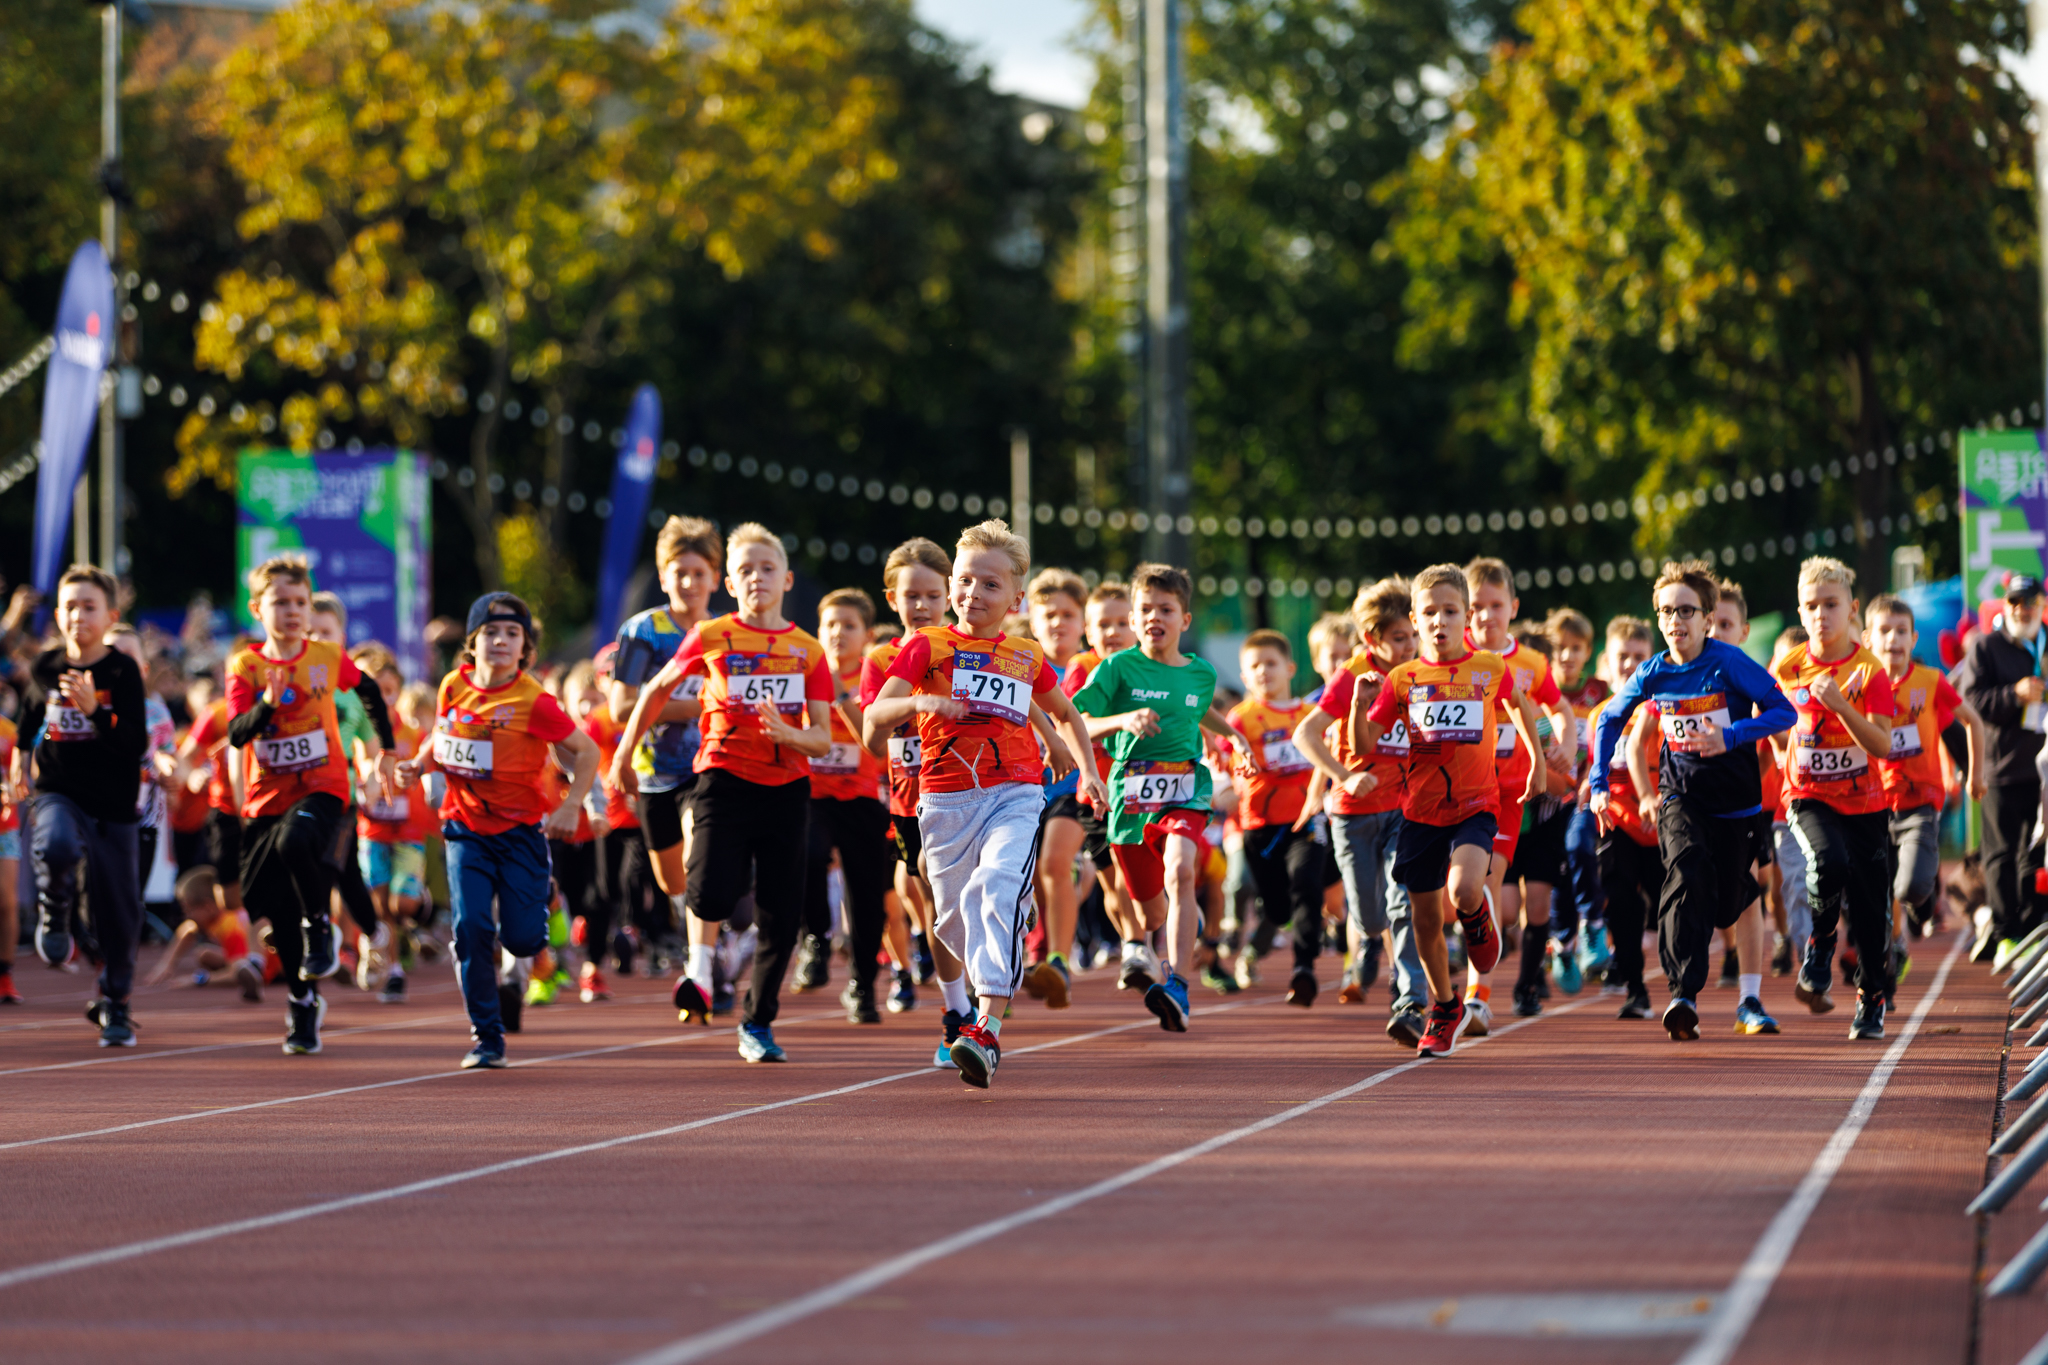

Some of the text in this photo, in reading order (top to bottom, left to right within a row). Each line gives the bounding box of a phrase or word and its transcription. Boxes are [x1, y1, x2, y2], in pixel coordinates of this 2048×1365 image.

[745, 678, 789, 700] 657
[972, 674, 1016, 706] 791
[1423, 704, 1467, 727] 642
[268, 738, 311, 763] 738
[444, 740, 476, 765] 764
[1811, 749, 1853, 771] 836
[1141, 777, 1179, 799] 691
